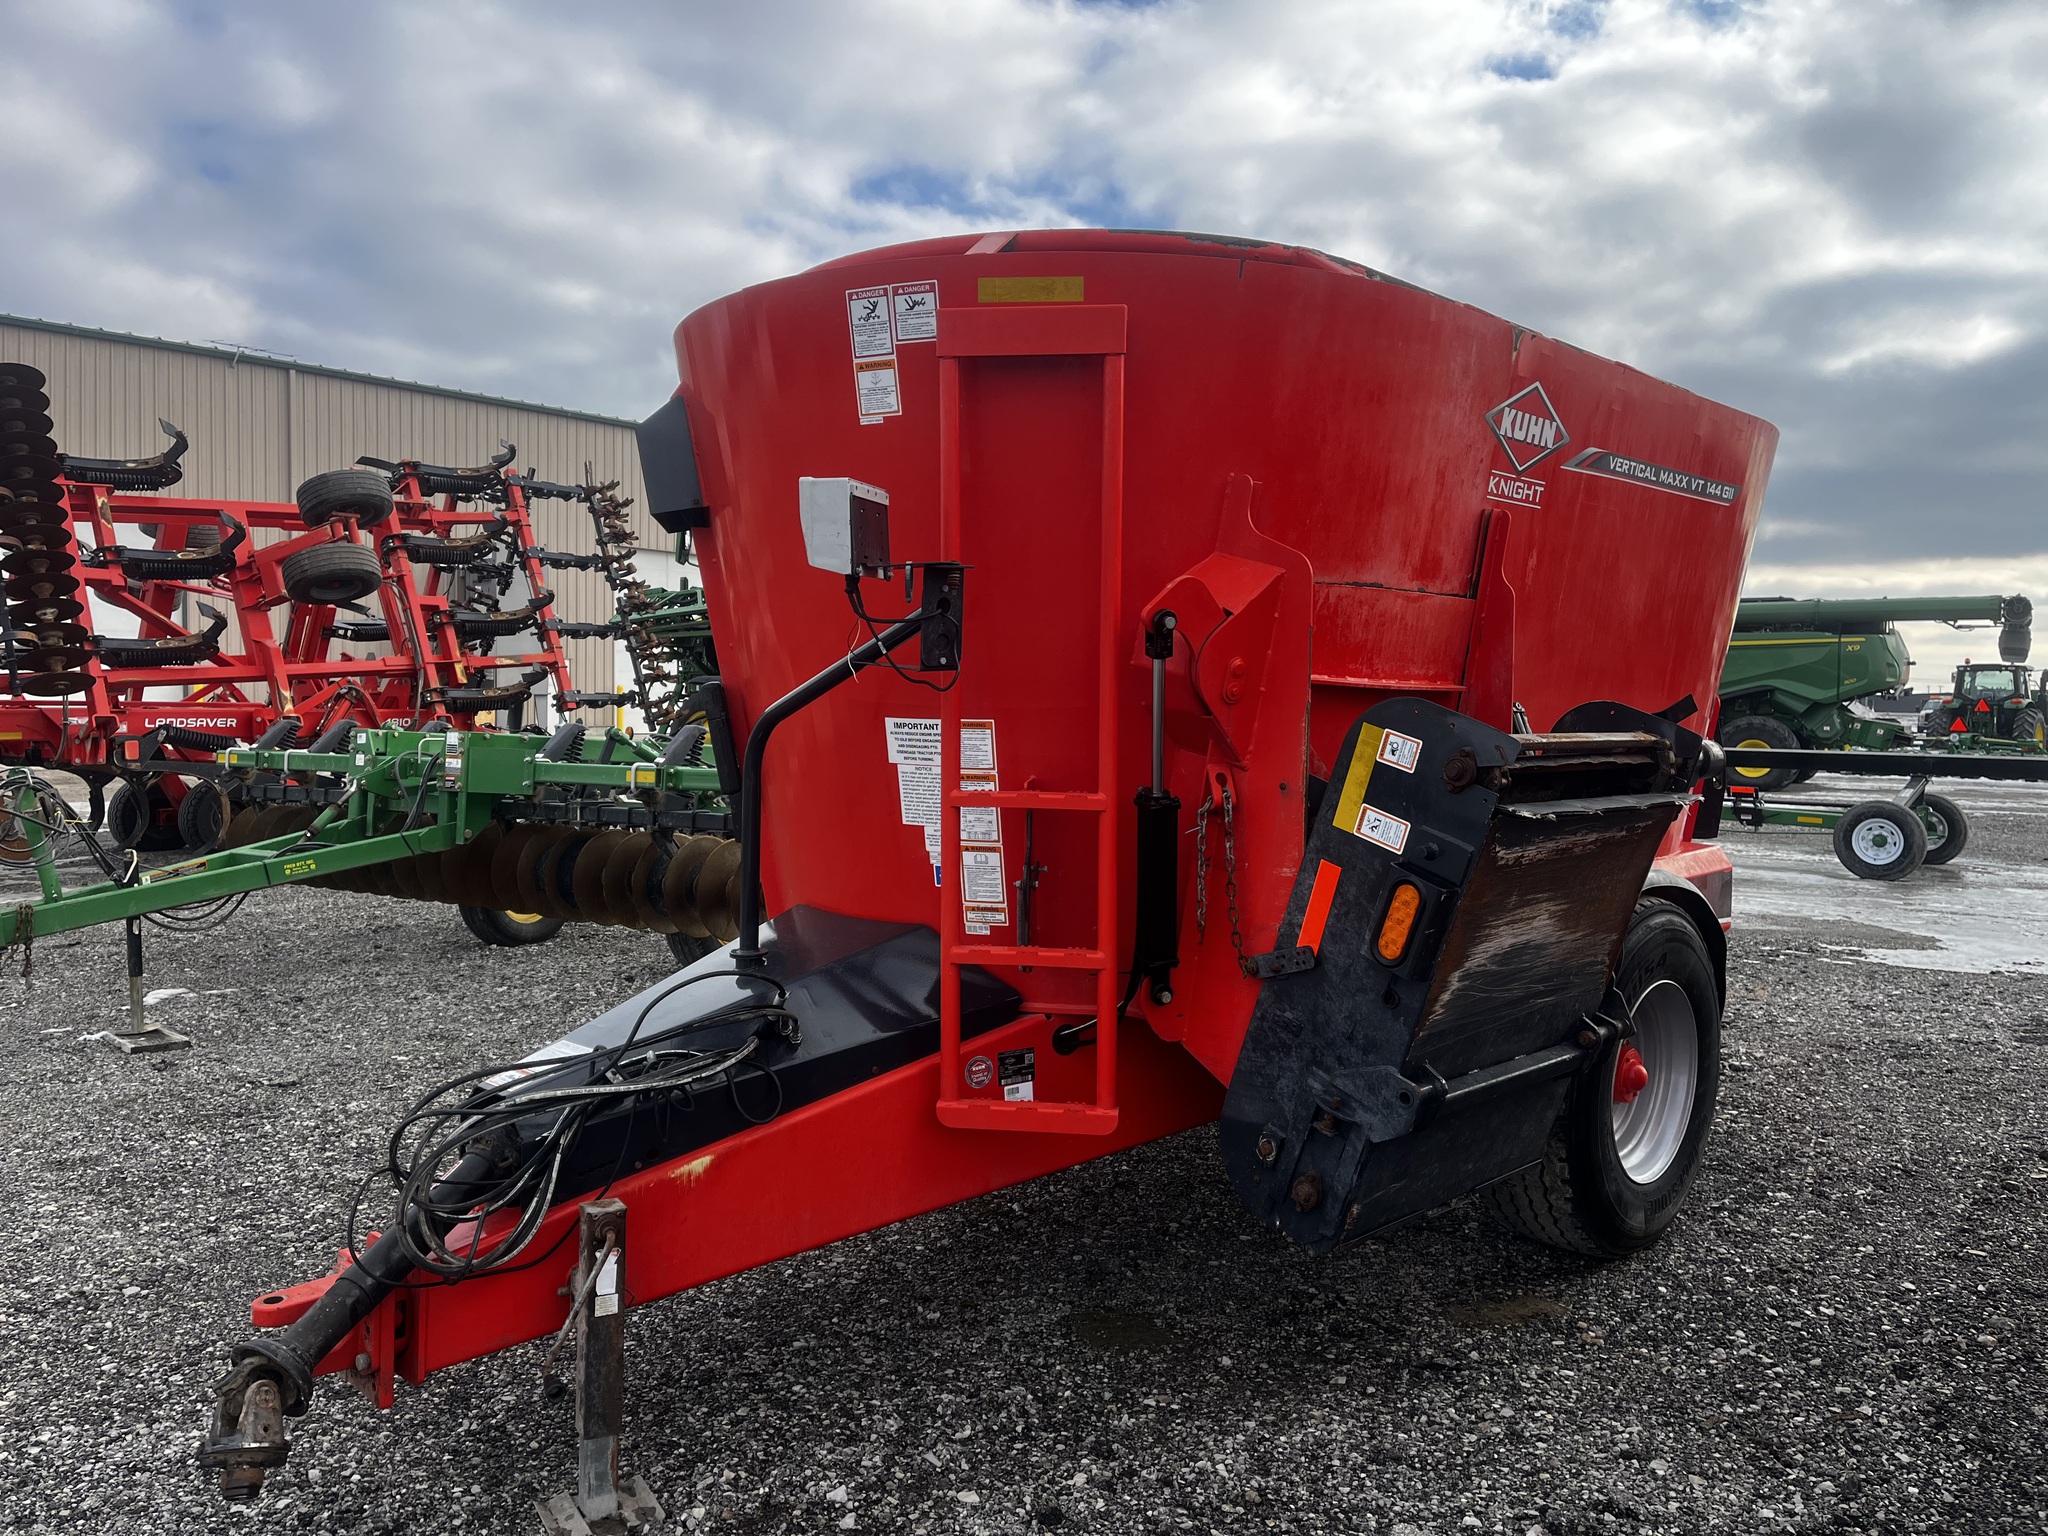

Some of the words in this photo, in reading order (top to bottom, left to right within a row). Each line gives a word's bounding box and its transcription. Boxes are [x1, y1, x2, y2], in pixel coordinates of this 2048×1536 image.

[904, 284, 930, 293] DANGER
[859, 290, 884, 298] DANGER
[1500, 406, 1557, 449] KUHN
[1610, 456, 1656, 480] VERTICAL
[1659, 470, 1688, 488] MAXX
[1692, 478, 1704, 492] VT
[1706, 482, 1721, 496] 144
[1722, 486, 1734, 499] GII
[1488, 476, 1544, 502] KNIGHT
[144, 718, 237, 728] LANDSAVER
[894, 722, 939, 730] IMPORTANT
